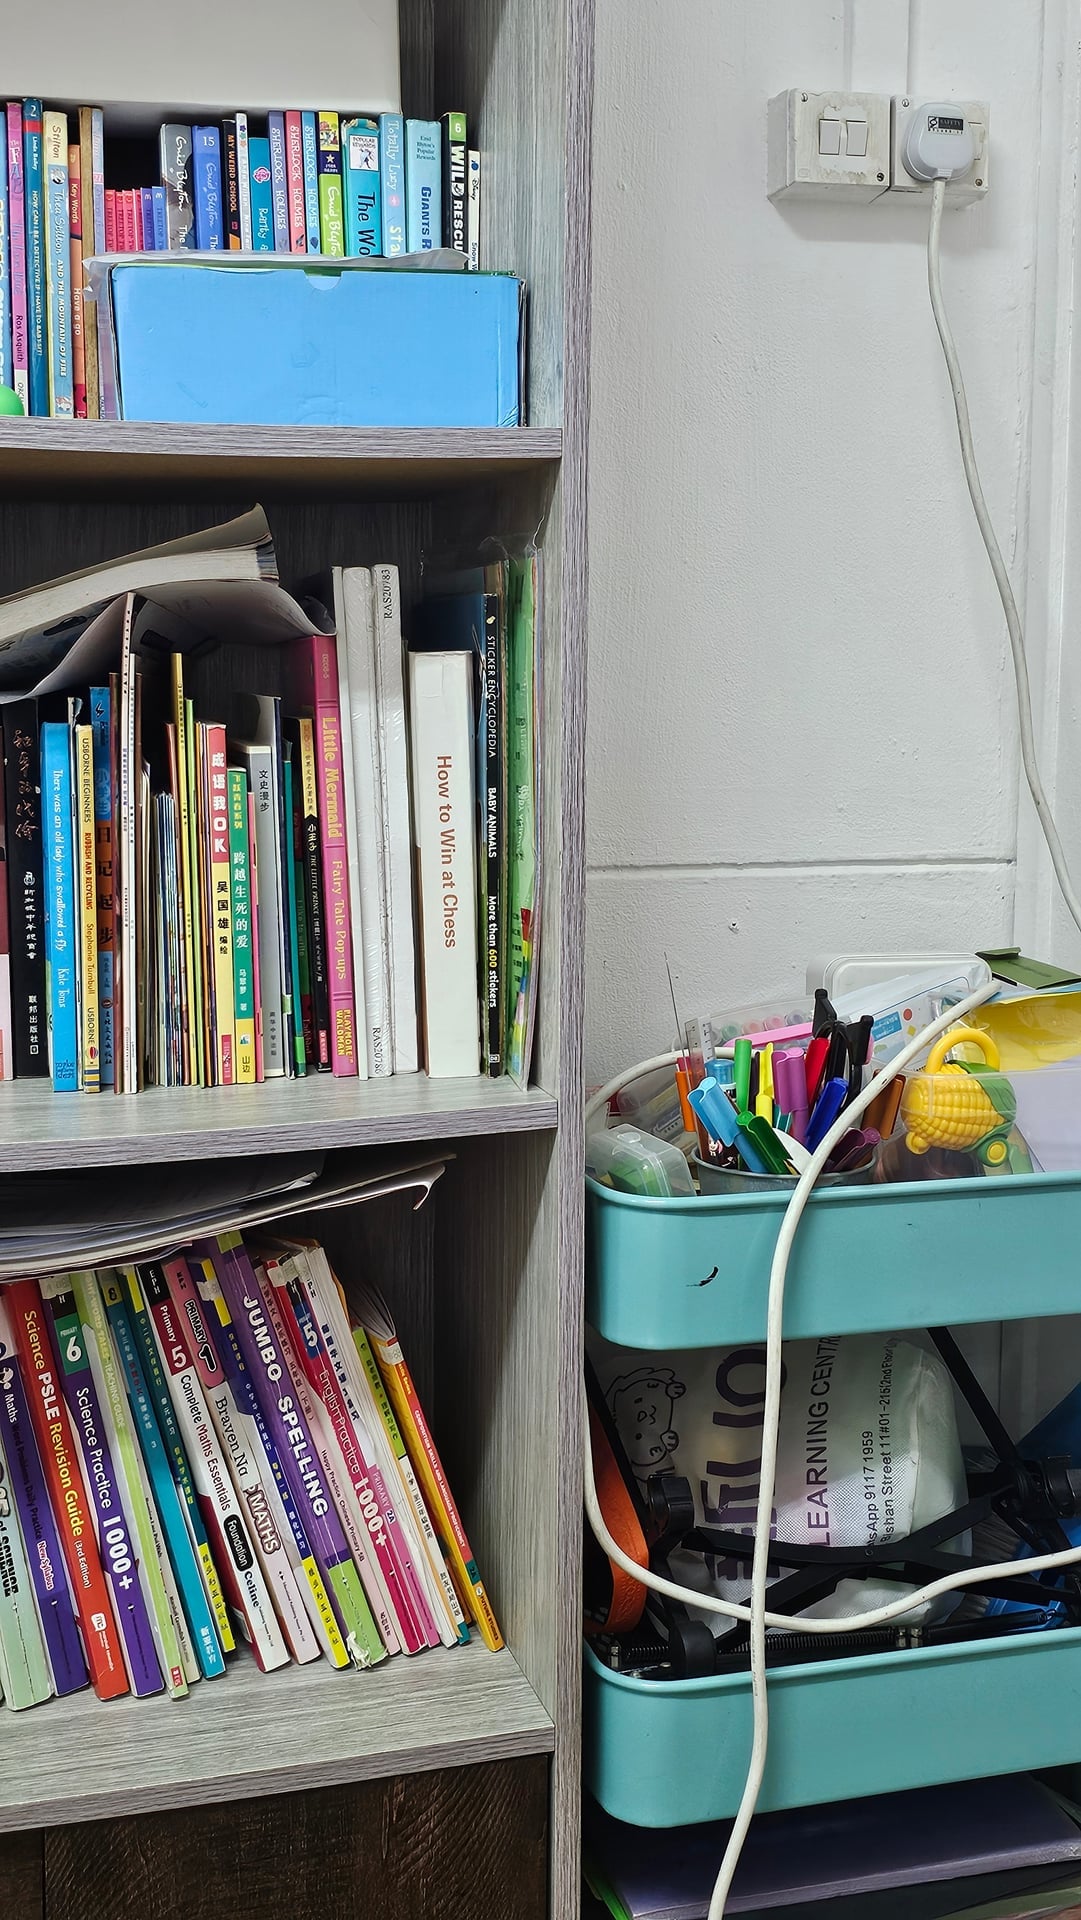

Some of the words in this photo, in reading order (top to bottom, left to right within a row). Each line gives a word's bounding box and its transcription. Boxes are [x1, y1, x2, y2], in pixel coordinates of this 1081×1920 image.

[29, 104, 38, 117] 2
[52, 125, 62, 159] Stilton
[203, 136, 215, 148] 15
[227, 134, 235, 147] MY
[387, 120, 400, 160] Totally
[454, 123, 462, 133] 6
[175, 136, 187, 167] Enid
[228, 151, 237, 178] WEIRD
[271, 127, 285, 184] SHERLOCK
[289, 125, 302, 181] SHERLOCK
[304, 125, 316, 181] SHERLOCK
[206, 163, 218, 188] Enid
[387, 164, 401, 191] Lucy
[450, 145, 466, 197] WILD
[54, 190, 65, 214] Thea
[70, 183, 78, 197] Key
[172, 170, 189, 212] Blyton
[229, 180, 237, 213] SCHOOL
[327, 185, 339, 216] Enid
[470, 178, 480, 201] Disney
[33, 209, 41, 225] CAN
[71, 199, 79, 224] Words
[205, 191, 217, 229] Blyton
[257, 207, 269, 239] Rarity
[275, 190, 287, 230] HOLMES
[292, 188, 304, 228] HOLMES
[307, 188, 319, 228] HOLMES
[357, 192, 376, 222] The
[420, 186, 432, 235] GIANTS
[54, 216, 66, 255] Stilton
[179, 225, 188, 244] The
[470, 242, 479, 261] Snow
[56, 260, 64, 277] AND
[57, 280, 65, 295] THE
[73, 288, 81, 312] Have
[15, 315, 23, 330] Ros
[57, 298, 66, 342] MOUNTAIN
[73, 324, 81, 336] go
[15, 331, 24, 362] Asquith
[59, 346, 66, 357] OF
[381, 568, 393, 619] RAS20783
[487, 635, 497, 676] STICKER
[487, 679, 498, 758] ENCYCLOPEDIA
[322, 717, 338, 762] Little
[82, 738, 91, 777] USBORNE
[54, 769, 65, 792] There
[259, 769, 270, 812] 文史漫步
[437, 754, 453, 799] How
[54, 794, 62, 812] was
[83, 778, 92, 823] BEGINNERS
[325, 767, 343, 839] Mermaid
[439, 803, 453, 822] to
[488, 787, 498, 813] BABY
[54, 815, 62, 829] an
[55, 831, 64, 843] old
[308, 823, 318, 852] 小王子
[488, 814, 498, 858] ANIMALS
[53, 846, 65, 862] lady
[85, 832, 93, 860] RUBBISH
[440, 828, 456, 865] Win
[55, 865, 65, 883] who
[331, 860, 345, 895] Fairy
[442, 870, 454, 888] at
[55, 886, 66, 928] swallowed
[86, 877, 94, 910] RECYCLING
[217, 880, 229, 929] 吴国雄
[234, 852, 249, 949] 跨越生死的爱
[312, 891, 320, 915] PRINCE
[488, 895, 498, 921] More
[334, 899, 345, 925] Tale
[442, 893, 459, 949] Chess
[54, 939, 66, 952] fly
[86, 923, 96, 961] Stephanie
[488, 923, 498, 947] than
[335, 930, 349, 980] Pop-ups
[488, 949, 498, 967] 600
[57, 968, 69, 985] Kate
[87, 964, 97, 994] Turnbull
[489, 970, 498, 1008] stickers
[58, 990, 69, 1008] Toms
[87, 1007, 96, 1044] USBORNE
[242, 1055, 251, 1073] 山边
[160, 1304, 177, 1343] Primary
[184, 1299, 208, 1343] PRIMARY
[302, 1322, 318, 1347] 5
[25, 1310, 45, 1370] Science
[66, 1336, 82, 1362] 6
[171, 1344, 187, 1368] 5
[199, 1343, 217, 1372] 1
[5, 1393, 17, 1423] Maths
[39, 1371, 60, 1421] PSLE
[243, 1295, 283, 1383] JUMBO
[278, 1394, 330, 1519] SPELLING
[215, 1395, 241, 1454] Braven
[50, 1422, 71, 1489] Revision
[319, 1370, 340, 1415] English
[337, 1416, 360, 1475] Practice
[355, 1477, 387, 1547] 1000+
[861, 1430, 874, 1463] 1959
[76, 1387, 97, 1447] Science
[90, 1449, 112, 1509] Practice
[102, 1515, 133, 1591] 1000+
[806, 1401, 831, 1547] LEARNING
[863, 1466, 877, 1500] 9117
[879, 1451, 894, 1496] Street
[181, 1374, 203, 1424] Complete
[195, 1423, 213, 1458] Maths
[207, 1458, 231, 1511] Essentials
[227, 1520, 248, 1568] Foundation
[244, 1570, 260, 1608] Celine
[321, 1449, 331, 1471] Happy
[329, 1471, 341, 1498] Practice
[339, 1500, 351, 1525] Chinese
[349, 1524, 360, 1551] Primary
[373, 1472, 391, 1508] PRIMARY
[386, 1509, 396, 1523] 2A
[434, 1468, 443, 1481] AND
[448, 1510, 467, 1547] PROFICIENCY
[65, 1490, 84, 1537] Guide
[74, 1540, 84, 1556] (3rd
[76, 1556, 92, 1589] Edition)
